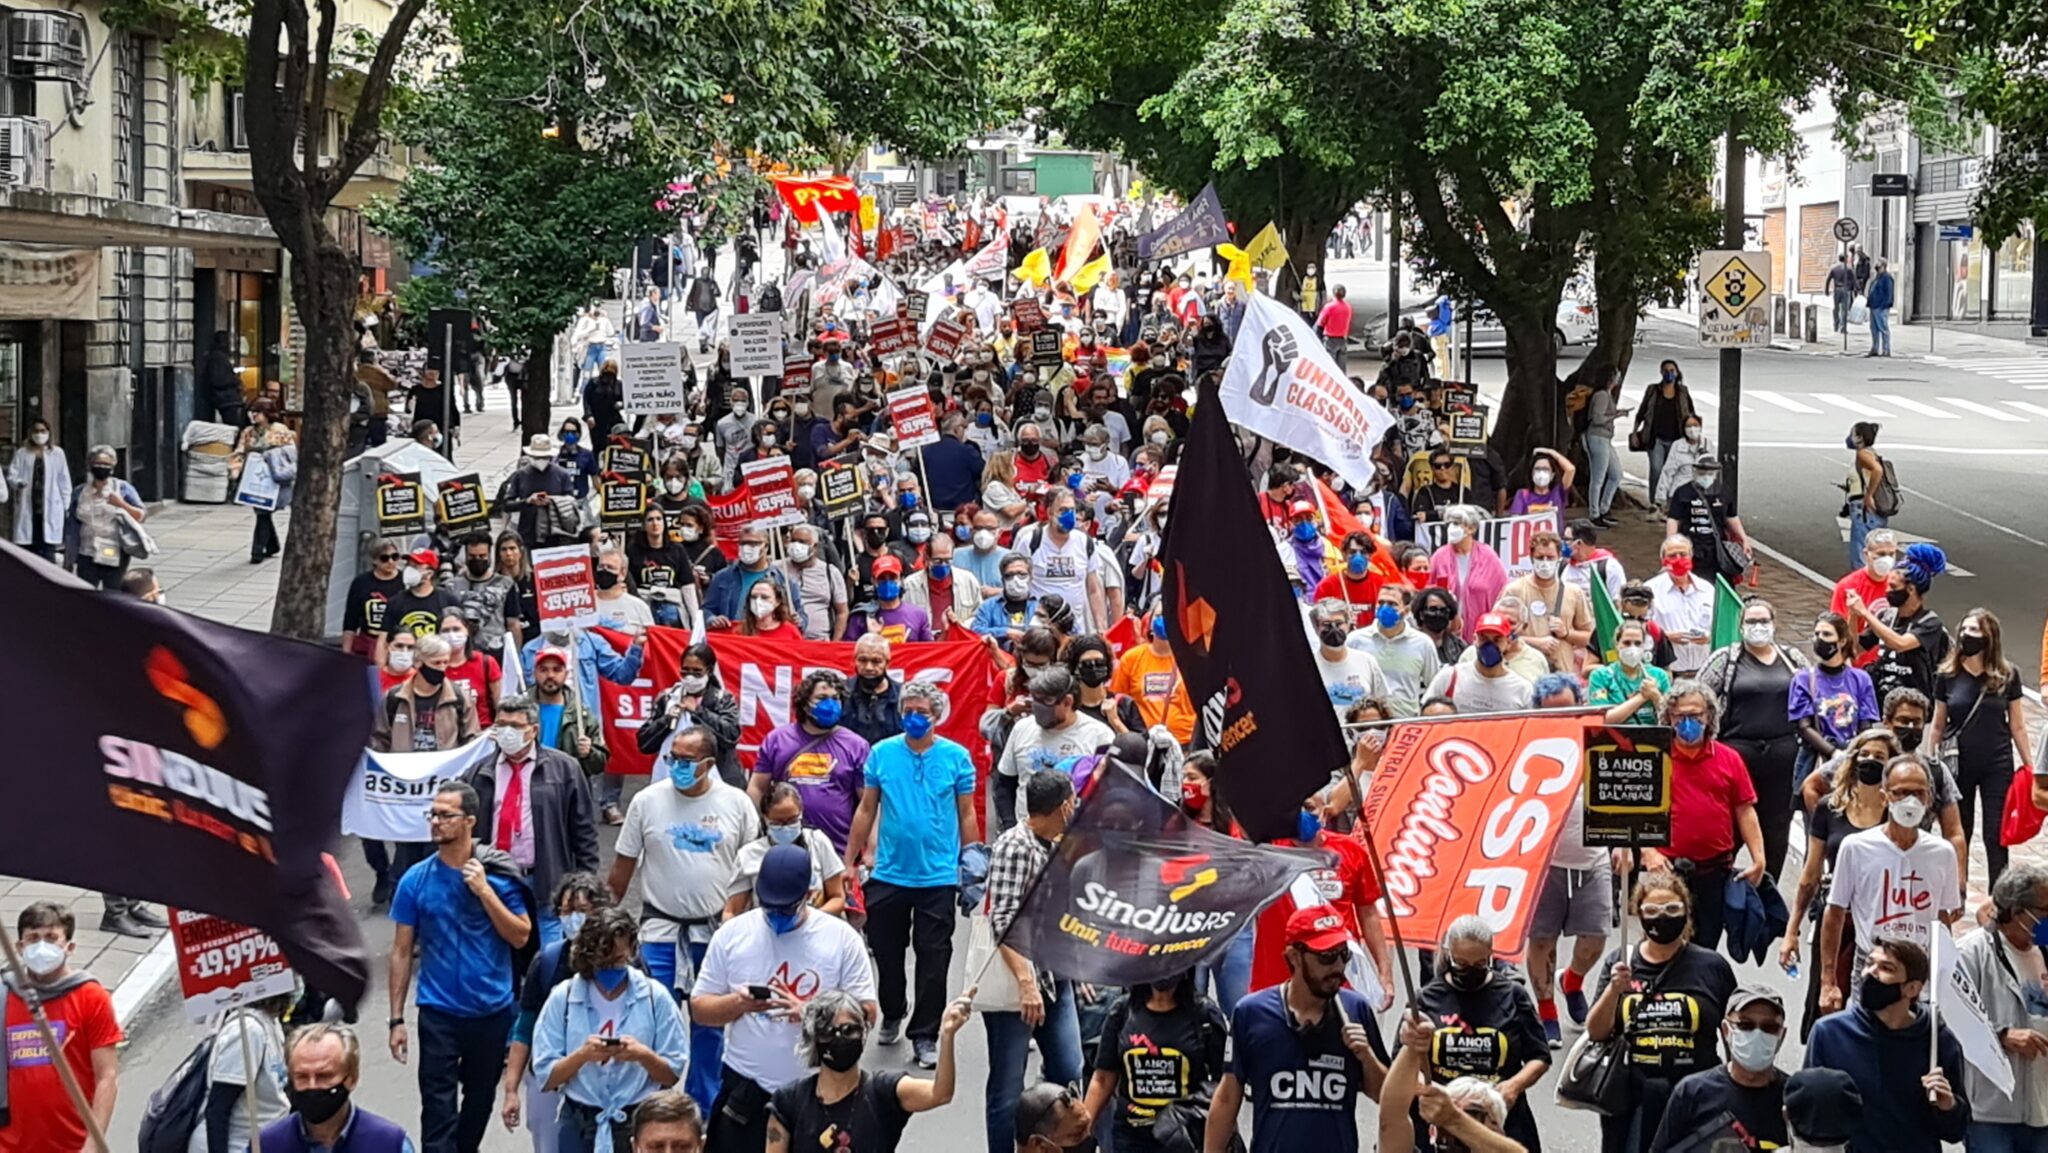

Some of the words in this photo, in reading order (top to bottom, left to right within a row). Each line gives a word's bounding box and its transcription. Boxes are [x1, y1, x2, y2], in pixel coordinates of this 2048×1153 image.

[635, 401, 652, 409] PEC
[656, 389, 676, 398] NÃO
[1286, 382, 1365, 446] CLASSISTA
[1295, 357, 1371, 433] UNIDADE
[546, 589, 593, 611] 19,99%
[1378, 726, 1423, 782] CENTRAL
[1598, 758, 1608, 771] 8
[1612, 758, 1653, 772] ANOS
[1463, 737, 1581, 934] CSP
[1875, 868, 1932, 925] Lute
[196, 933, 280, 979] 19,99%
[1059, 913, 1103, 947] Unir,
[1148, 942, 1161, 956] e
[1457, 1036, 1492, 1048] ANOS
[1269, 1069, 1348, 1102] CNG
